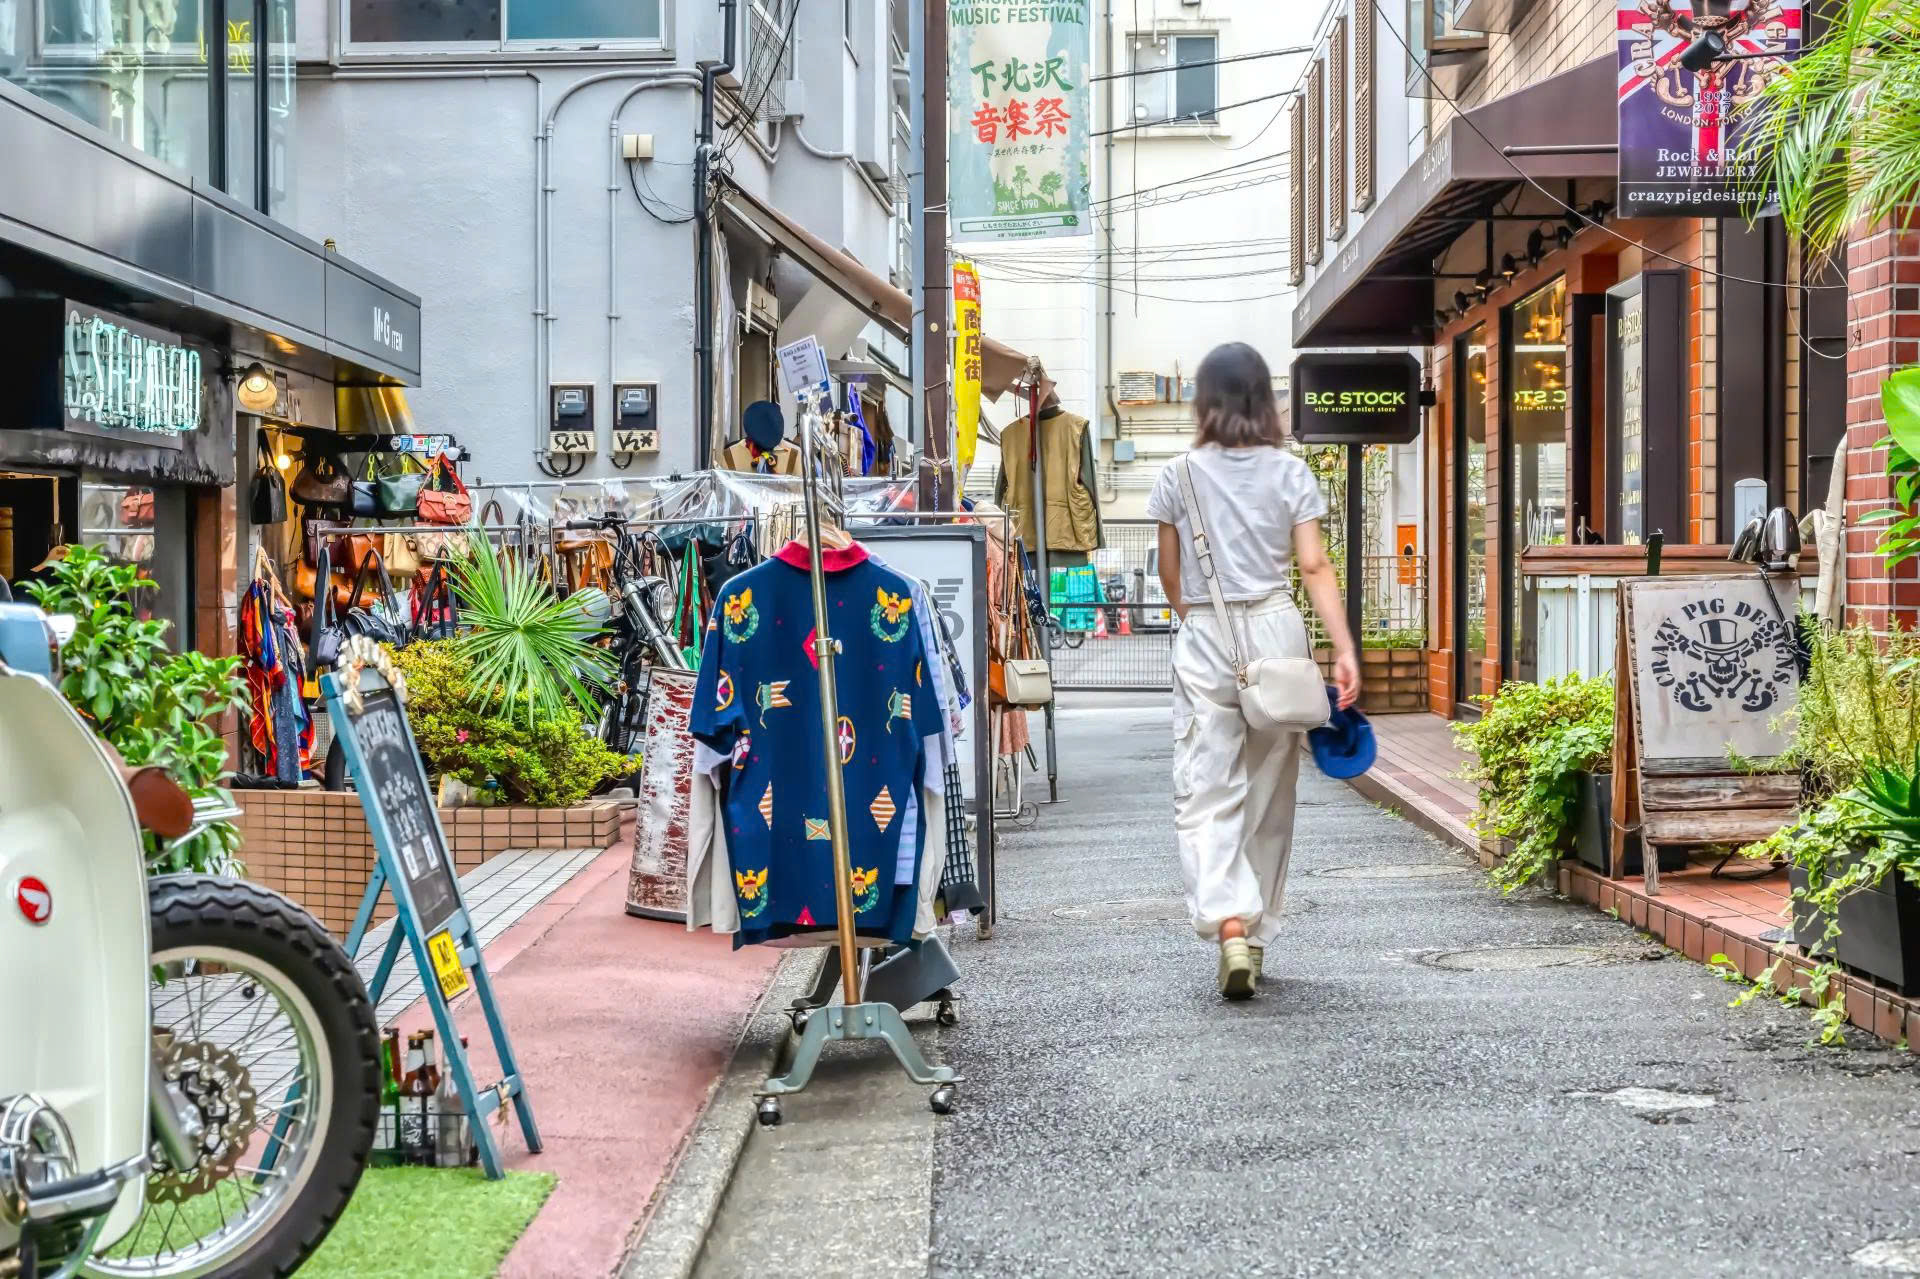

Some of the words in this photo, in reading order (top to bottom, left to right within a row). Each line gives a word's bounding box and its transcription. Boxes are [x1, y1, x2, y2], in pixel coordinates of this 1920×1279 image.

[952, 8, 1001, 27] MUSIC
[1007, 7, 1084, 26] FESTIVAL
[970, 57, 1074, 98] 下北沢
[1695, 91, 1732, 103] 1992
[1694, 103, 1731, 115] 2017
[970, 97, 1072, 144] 音楽祭
[1657, 149, 1700, 162] Rock
[1706, 150, 1720, 162] &
[1656, 166, 1759, 177] JEWELLERY
[997, 201, 1020, 212] SINCE
[91, 317, 143, 418] STEP
[1304, 391, 1335, 405] B.C
[1340, 391, 1406, 405] STOCK
[1651, 617, 1681, 688] CRAZY
[1681, 598, 1725, 621] PIG
[1734, 601, 1795, 685] DESIGNS
